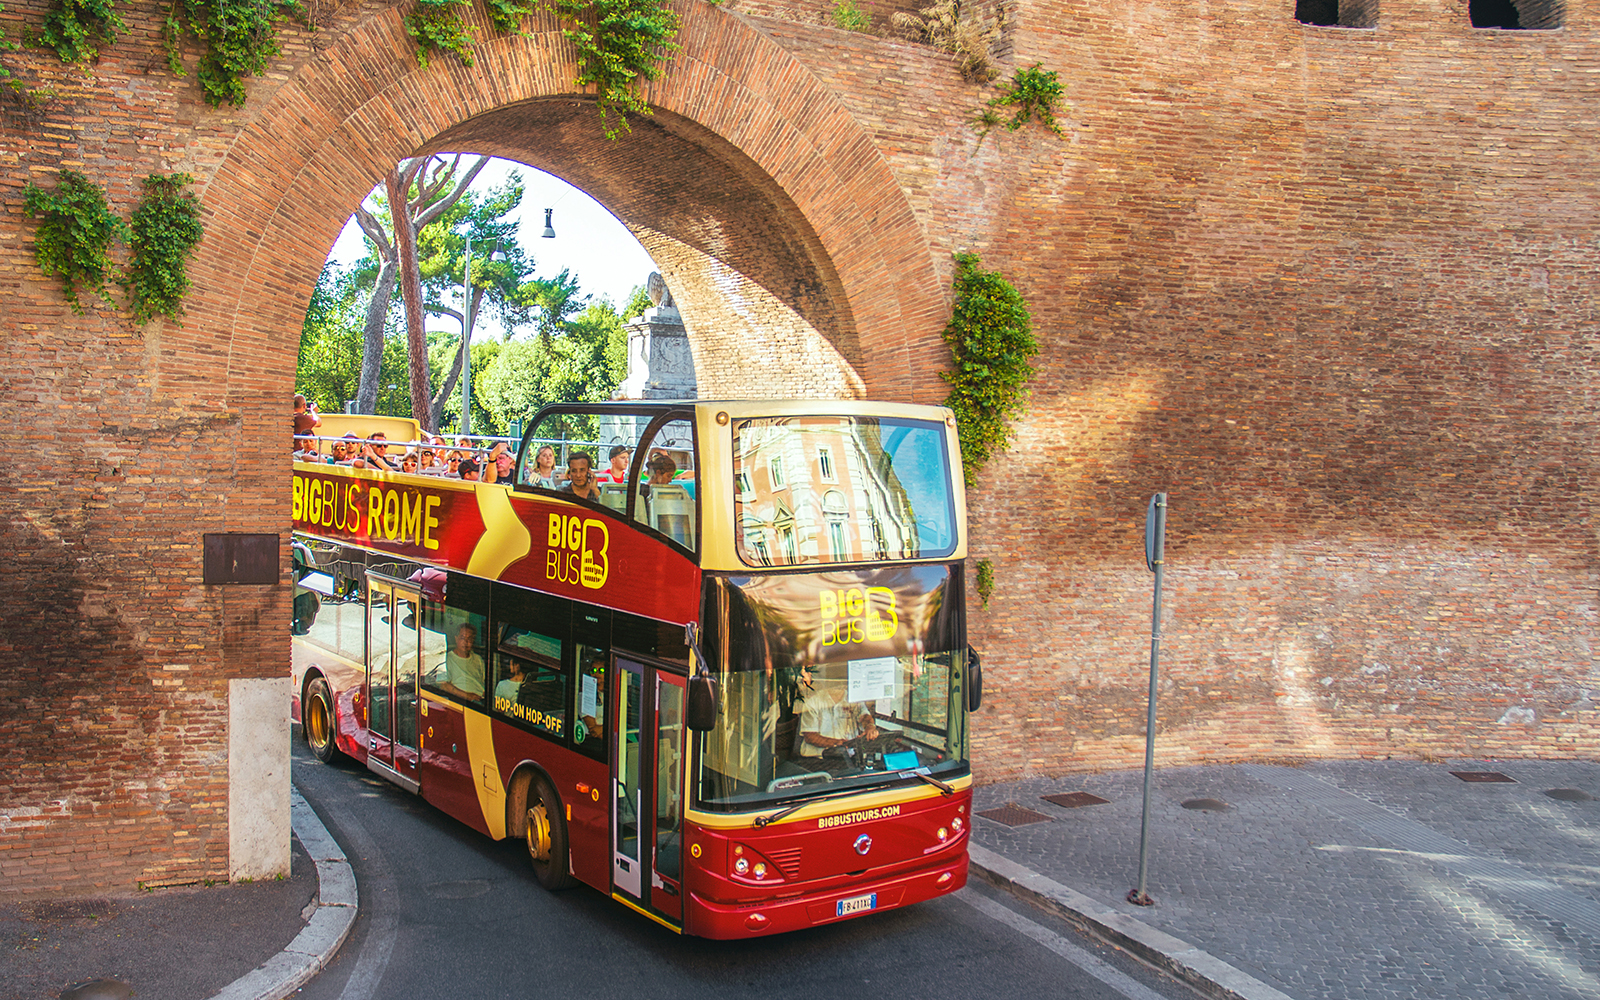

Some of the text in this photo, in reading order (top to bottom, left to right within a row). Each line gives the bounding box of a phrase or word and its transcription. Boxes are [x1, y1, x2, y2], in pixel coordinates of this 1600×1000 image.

[367, 486, 441, 550] ROME
[548, 513, 581, 551] BIG
[546, 549, 580, 585] BUS
[819, 588, 864, 619] BIG
[821, 617, 865, 646] BUS
[494, 695, 562, 733] HOP-ON HOP-OFF
[818, 805, 900, 829] BIGBUSTOURS.COM
